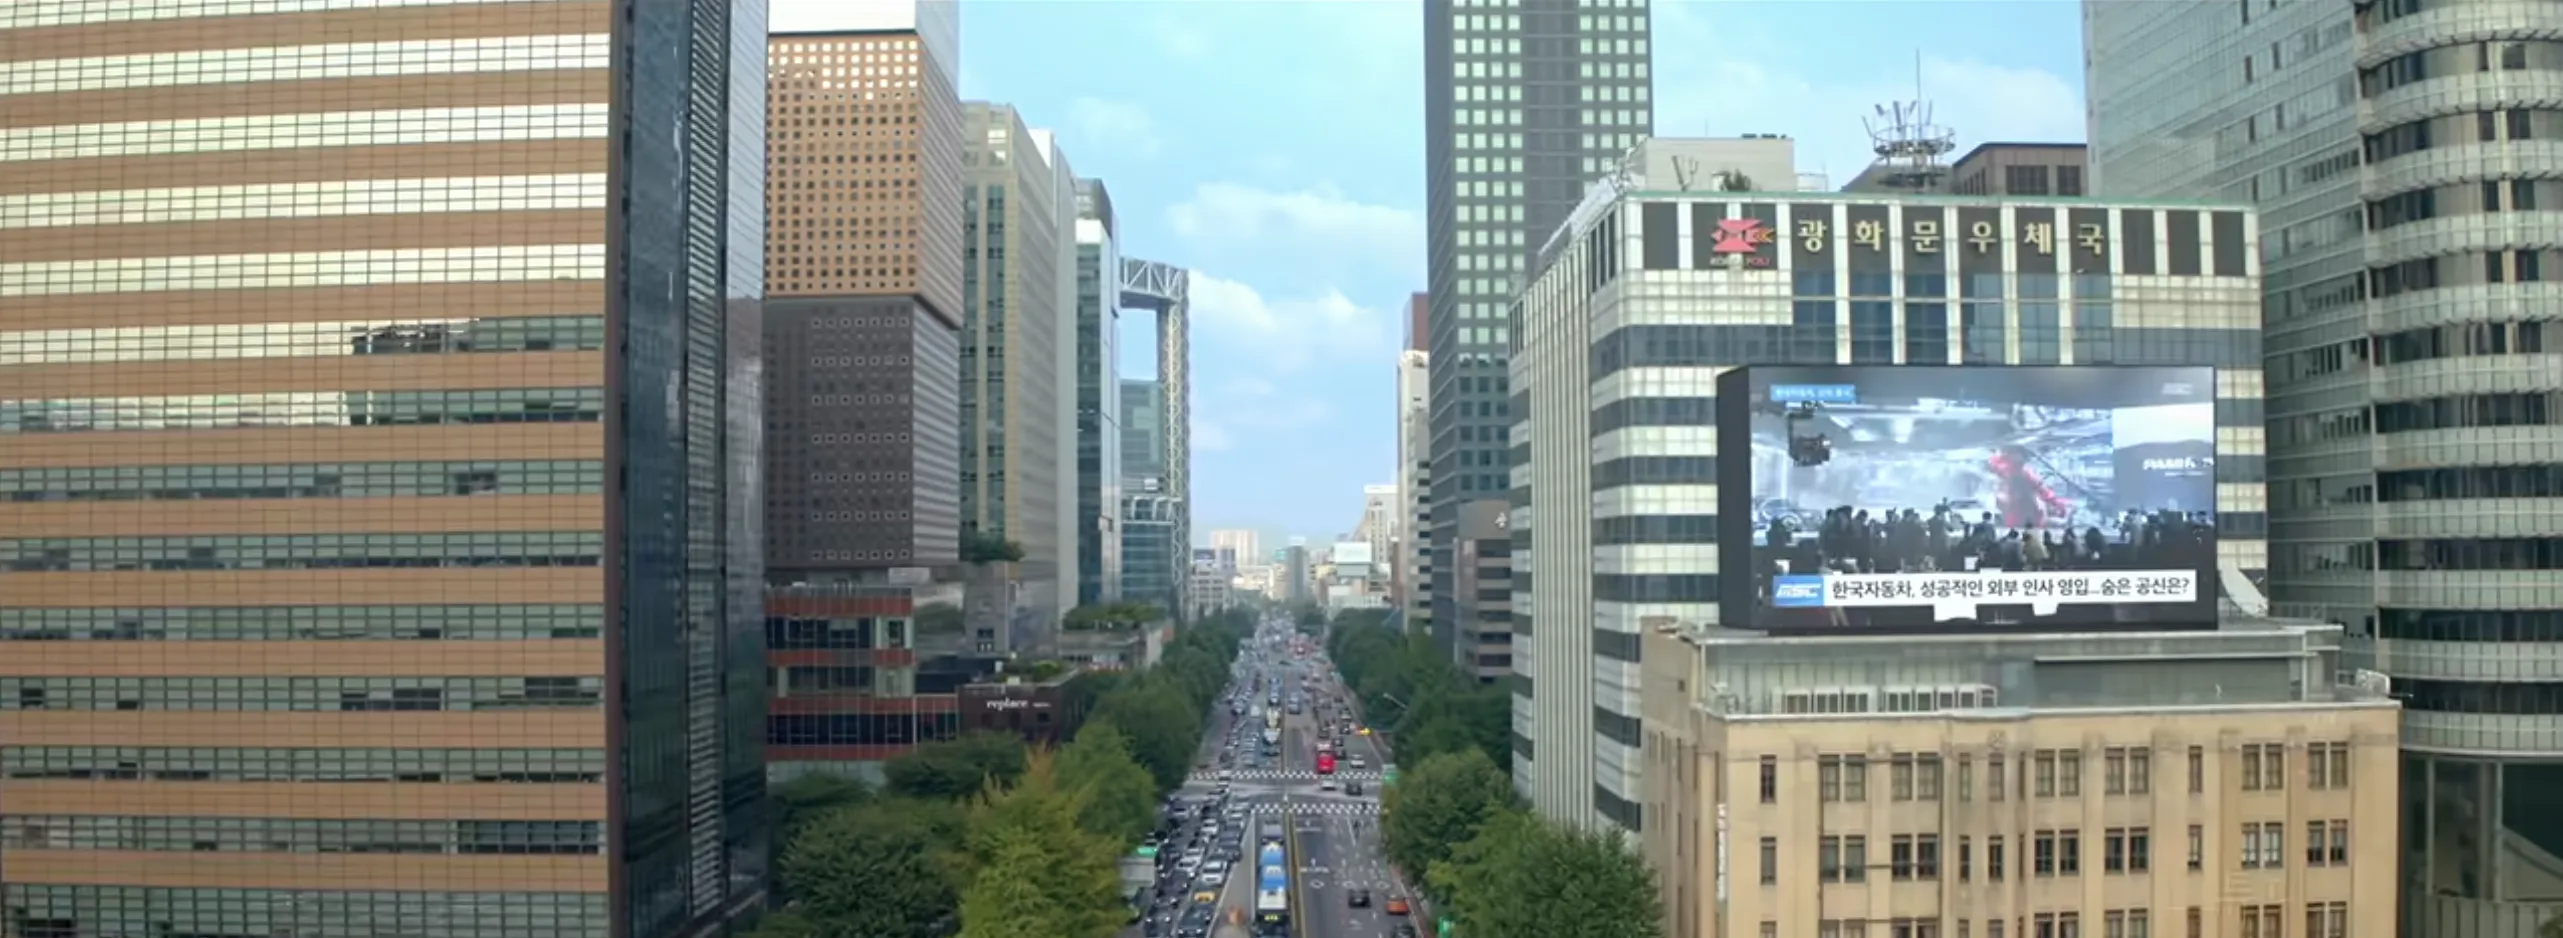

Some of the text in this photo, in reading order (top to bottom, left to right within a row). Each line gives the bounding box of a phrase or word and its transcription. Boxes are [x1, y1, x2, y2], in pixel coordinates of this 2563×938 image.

[1798, 219, 2104, 255] 광화문우체국
[1832, 579, 1916, 599] 한국자동차,
[1920, 579, 1984, 598] 성공적인
[1987, 579, 2018, 597] 외부
[2022, 578, 2054, 597] 인사
[2135, 576, 2190, 596] 공신은?
[986, 697, 1028, 711] replace
